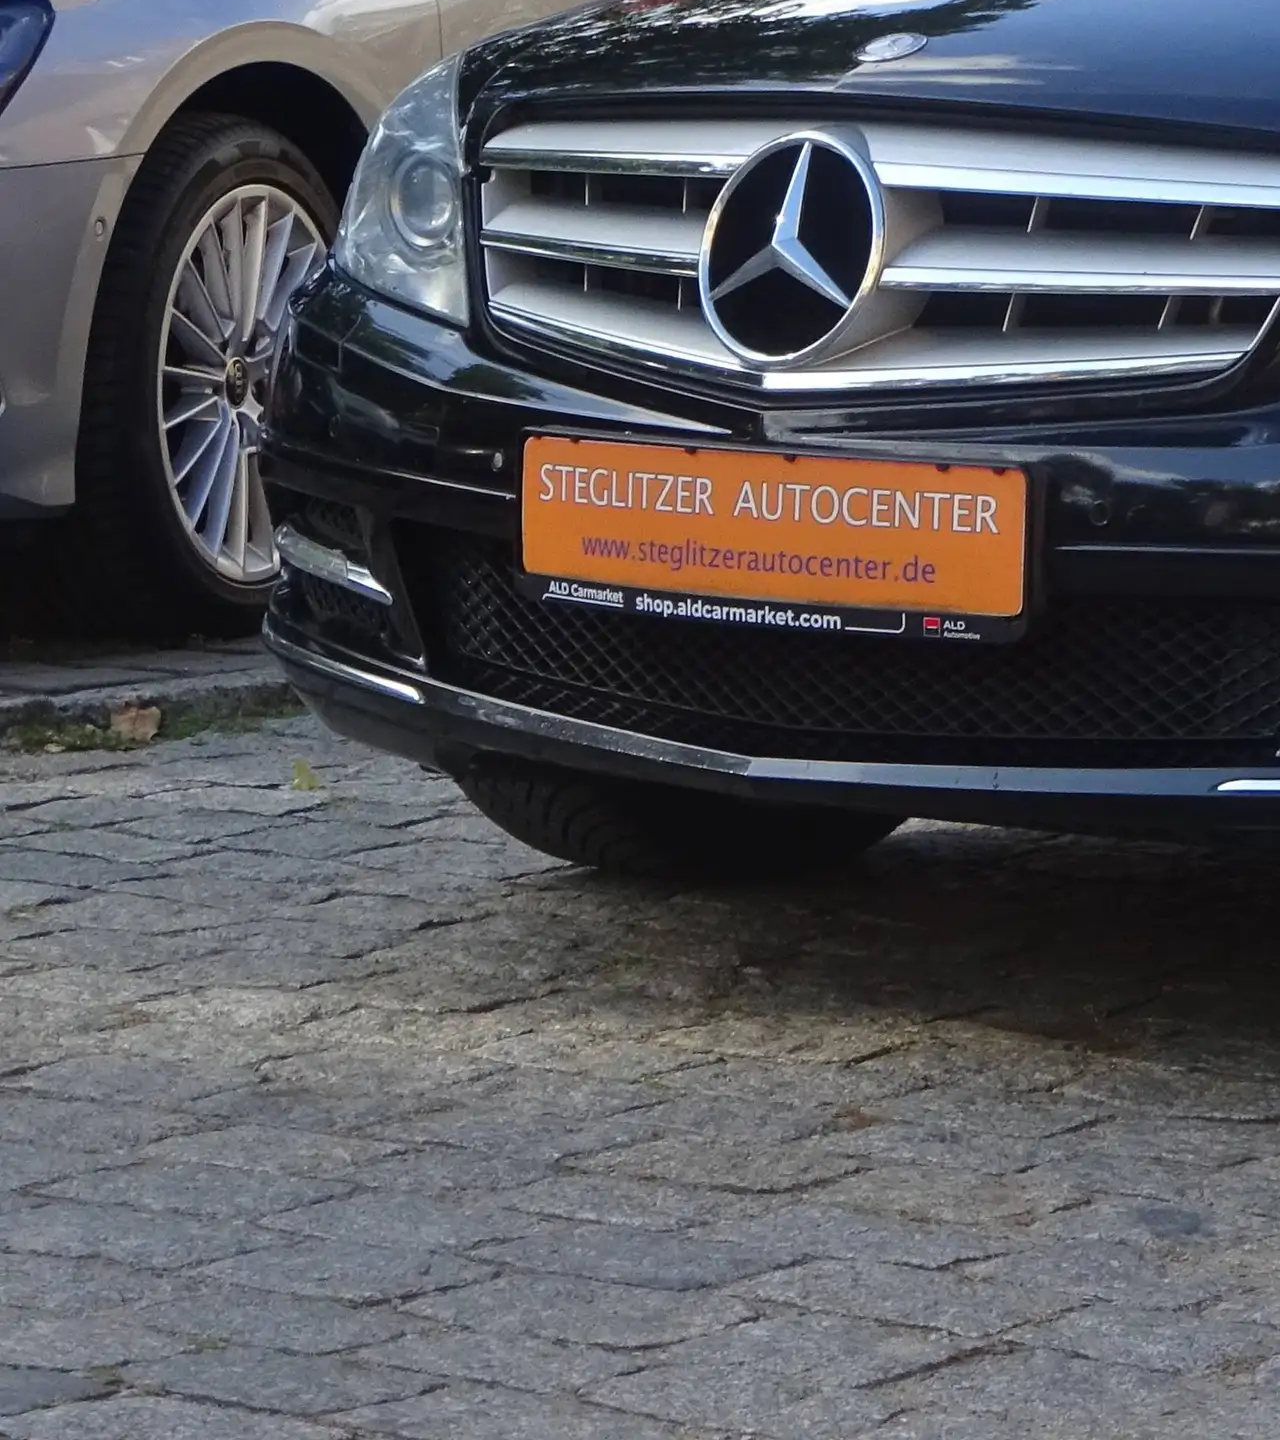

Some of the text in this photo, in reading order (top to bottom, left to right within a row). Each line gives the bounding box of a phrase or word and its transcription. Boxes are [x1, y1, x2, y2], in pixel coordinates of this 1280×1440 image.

[539, 463, 999, 534] STEGLITZER AUTOCENTER
[582, 535, 936, 583] www.steglitzerautocenter.de
[549, 580, 841, 630] ALD Carmarket shop.aldcarmarket.com
[943, 620, 966, 630] ALD
